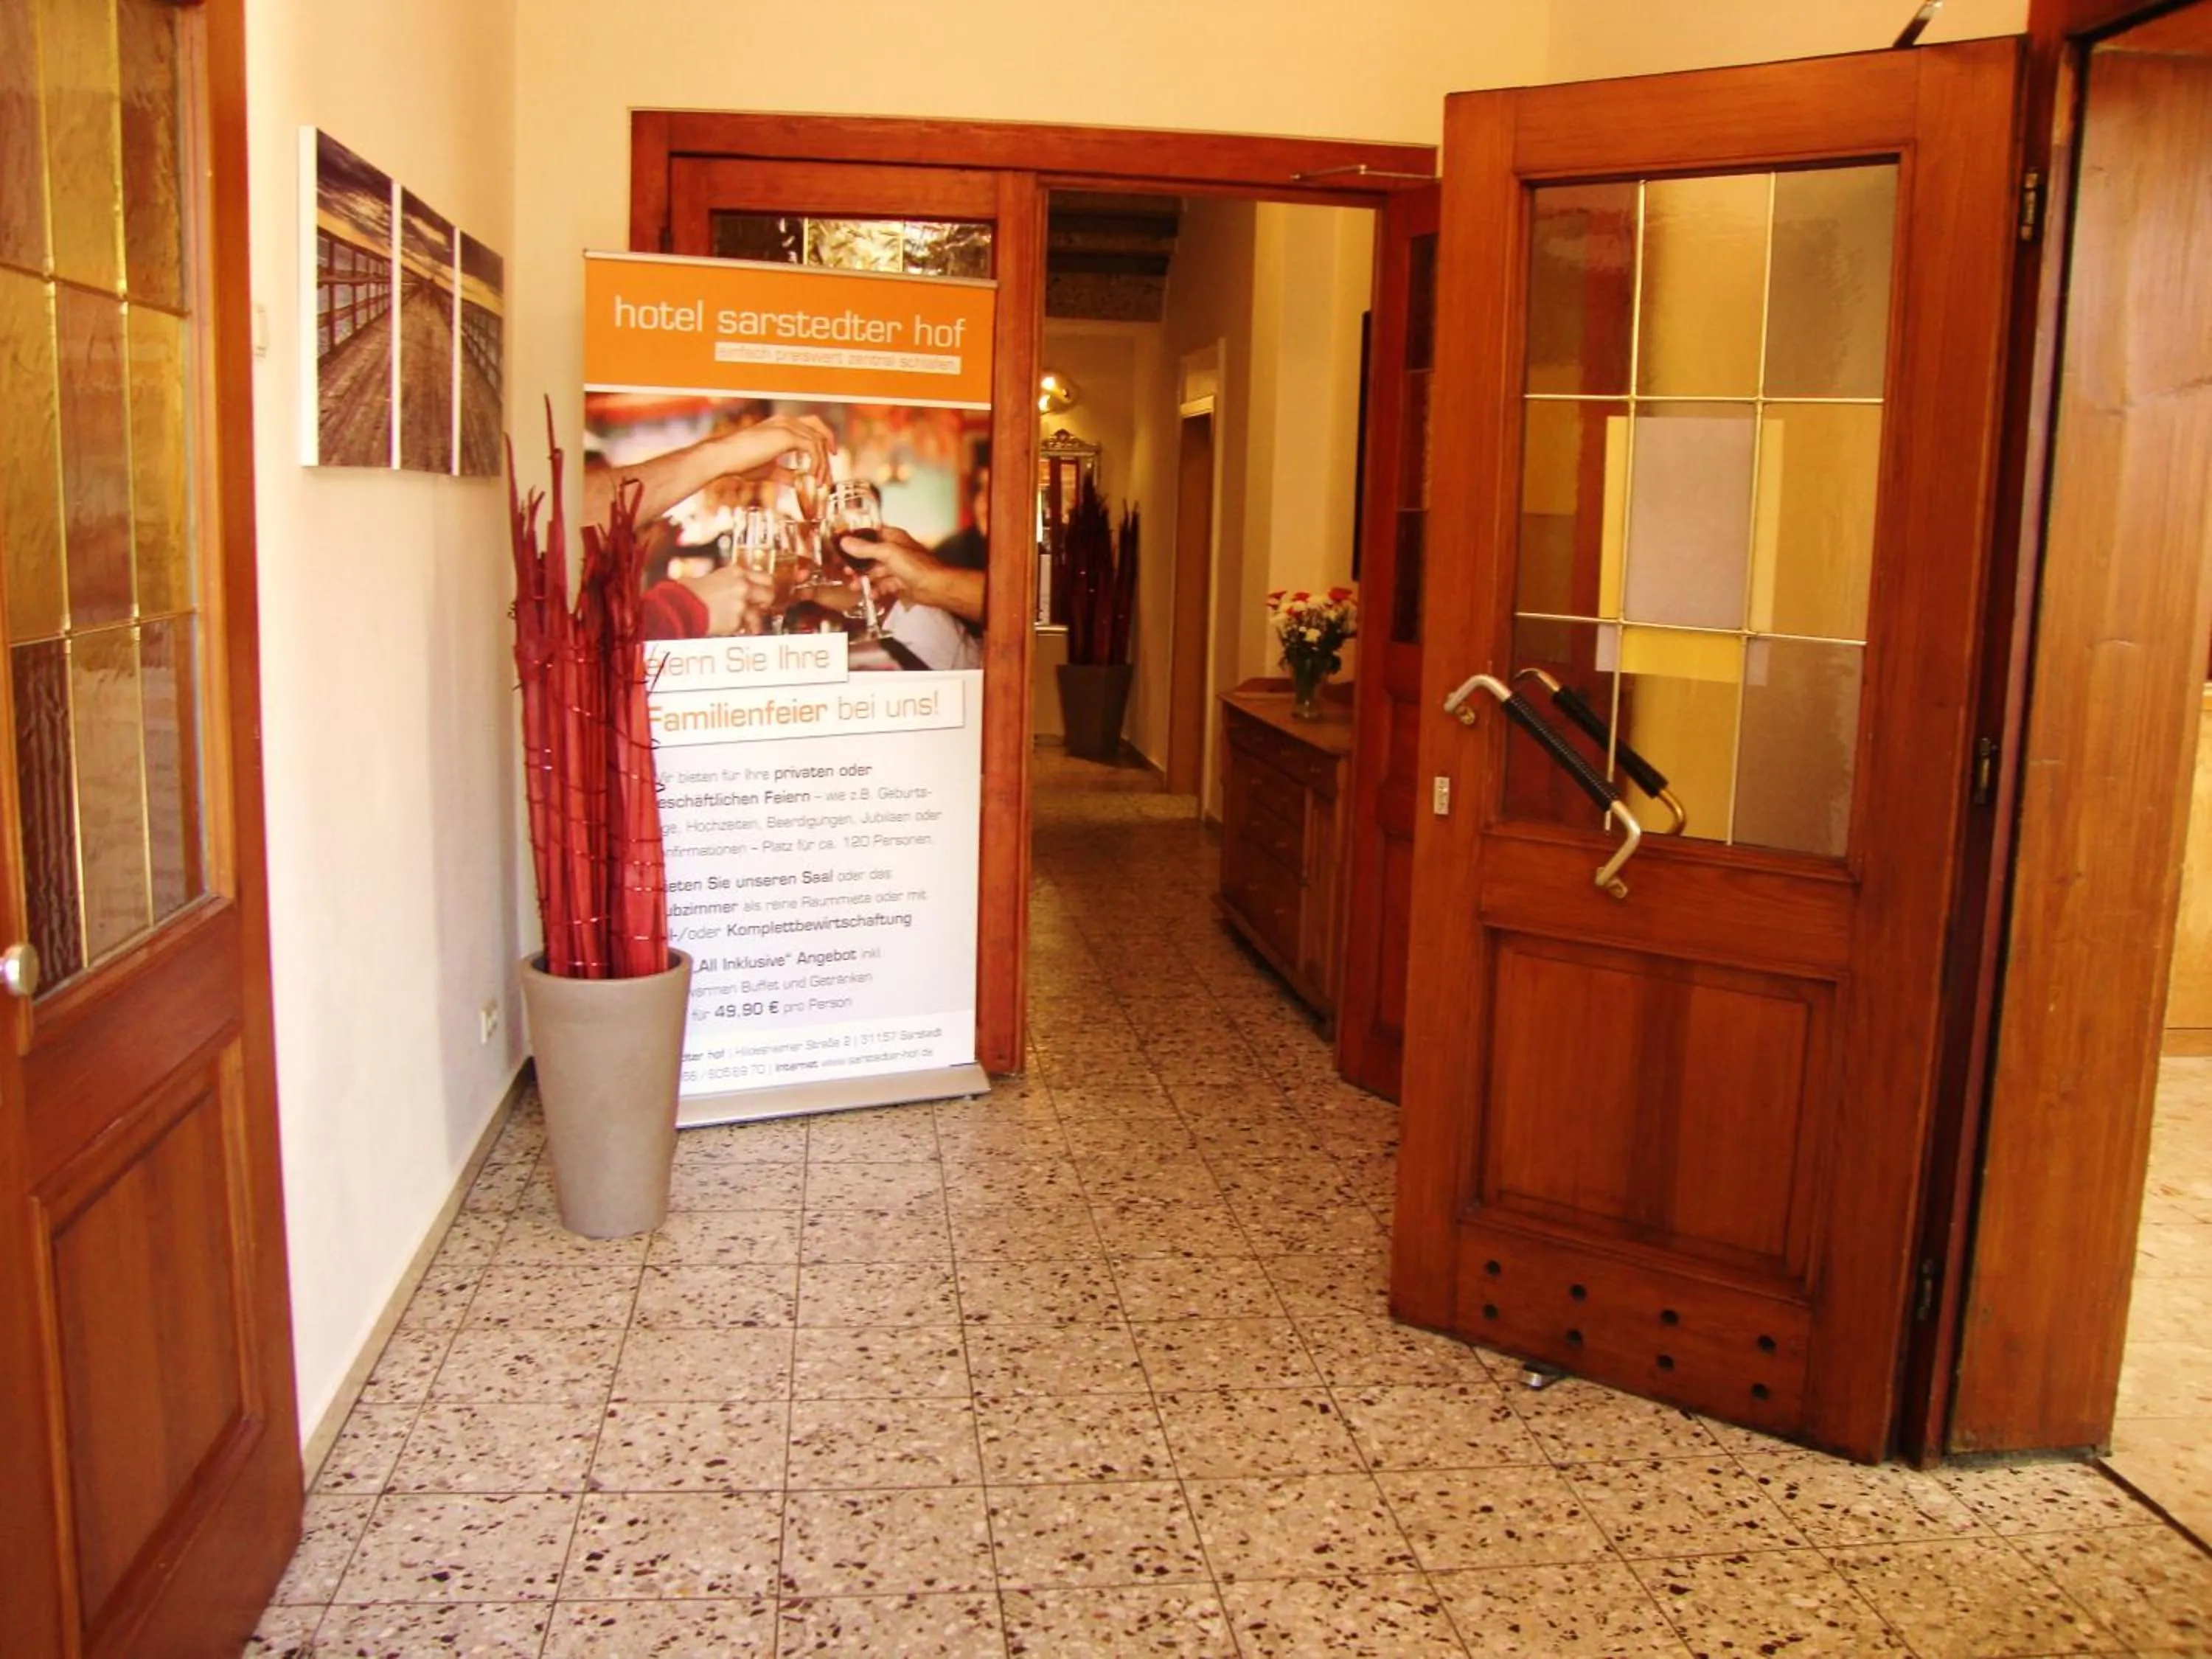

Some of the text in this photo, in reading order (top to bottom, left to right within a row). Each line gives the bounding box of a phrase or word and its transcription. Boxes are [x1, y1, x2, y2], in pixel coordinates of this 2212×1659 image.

[614, 295, 966, 348] hotel sarstedter hof
[647, 644, 830, 677] eiern Sie Ihre
[838, 695, 875, 720] bei
[886, 691, 939, 718] uns!
[678, 771, 717, 784] bieten
[722, 769, 740, 782] für
[745, 768, 770, 780] Ihre
[774, 765, 833, 782] privaten
[839, 764, 872, 778] oder
[657, 791, 759, 809] eschäftlichen
[764, 790, 810, 804] Feiern
[827, 790, 846, 801] wie
[877, 785, 933, 800] Geburts-
[915, 810, 943, 822] oder
[762, 841, 793, 853] Platz
[797, 839, 815, 852] für
[844, 835, 870, 848] 120
[708, 875, 731, 891] Sie
[736, 873, 797, 889] unseren
[801, 869, 834, 884] Saal
[838, 869, 865, 883] oder
[869, 868, 893, 881] das
[742, 900, 762, 912] als
[766, 897, 798, 911] reine
[801, 892, 872, 908] Raummiete
[875, 891, 903, 903] oder
[908, 888, 927, 902] mit
[726, 912, 913, 937] Komplettbewirtschaftung
[796, 948, 857, 967] Angebot
[742, 979, 780, 994] Buffet
[783, 976, 807, 990] und
[810, 972, 873, 989] Getränken
[768, 1001, 780, 1015] €
[783, 1001, 805, 1015] pro
[809, 997, 852, 1010] Person
